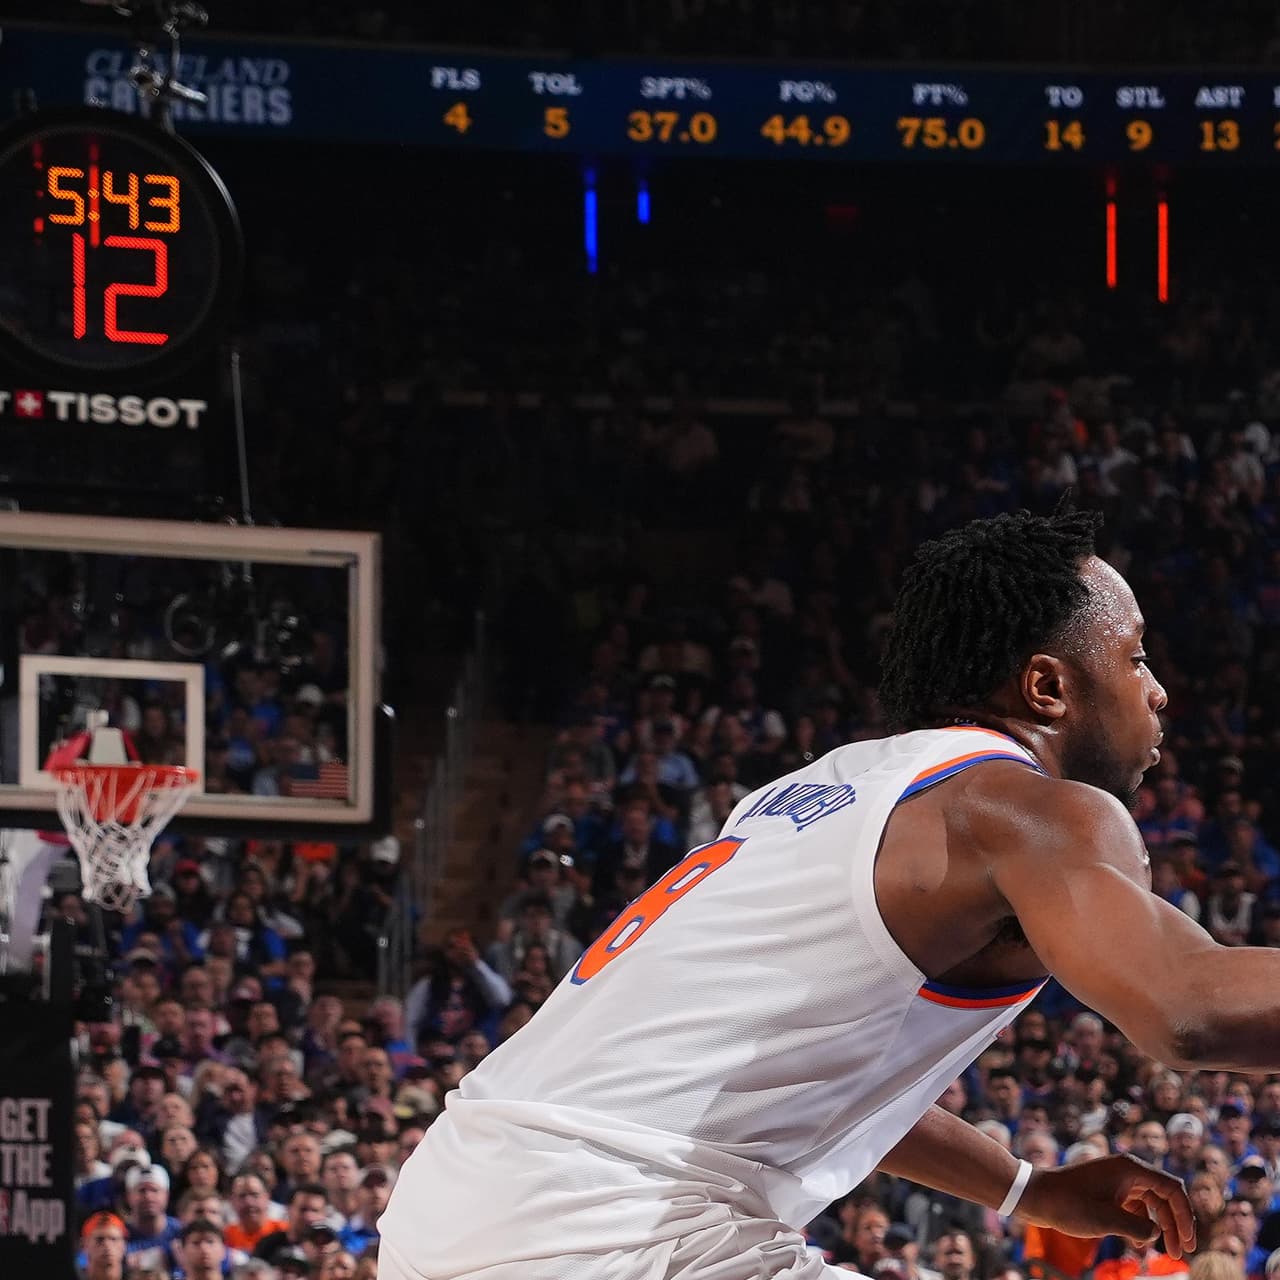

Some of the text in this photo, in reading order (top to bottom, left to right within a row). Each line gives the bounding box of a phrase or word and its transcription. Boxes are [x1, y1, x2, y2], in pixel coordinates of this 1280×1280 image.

[431, 66, 480, 90] FLS
[528, 71, 582, 95] TOL
[912, 83, 968, 105] FT%
[1045, 85, 1083, 107] TO
[1116, 85, 1165, 107] STL
[1195, 85, 1245, 107] AST
[443, 102, 472, 134] 4
[543, 106, 570, 138] 5
[628, 110, 718, 143] 37.0
[760, 114, 850, 147] 44.9
[897, 117, 986, 149] 75.0
[1044, 119, 1085, 150] 14
[1126, 119, 1152, 150] 9
[1200, 119, 1240, 150] 13
[48, 166, 180, 233] 5:43
[73, 233, 168, 345] 12
[48, 391, 207, 428] TISSOT
[570, 834, 750, 986] 8
[0, 1098, 50, 1141] GET
[2, 1143, 53, 1186] THE
[11, 1190, 66, 1243] App
